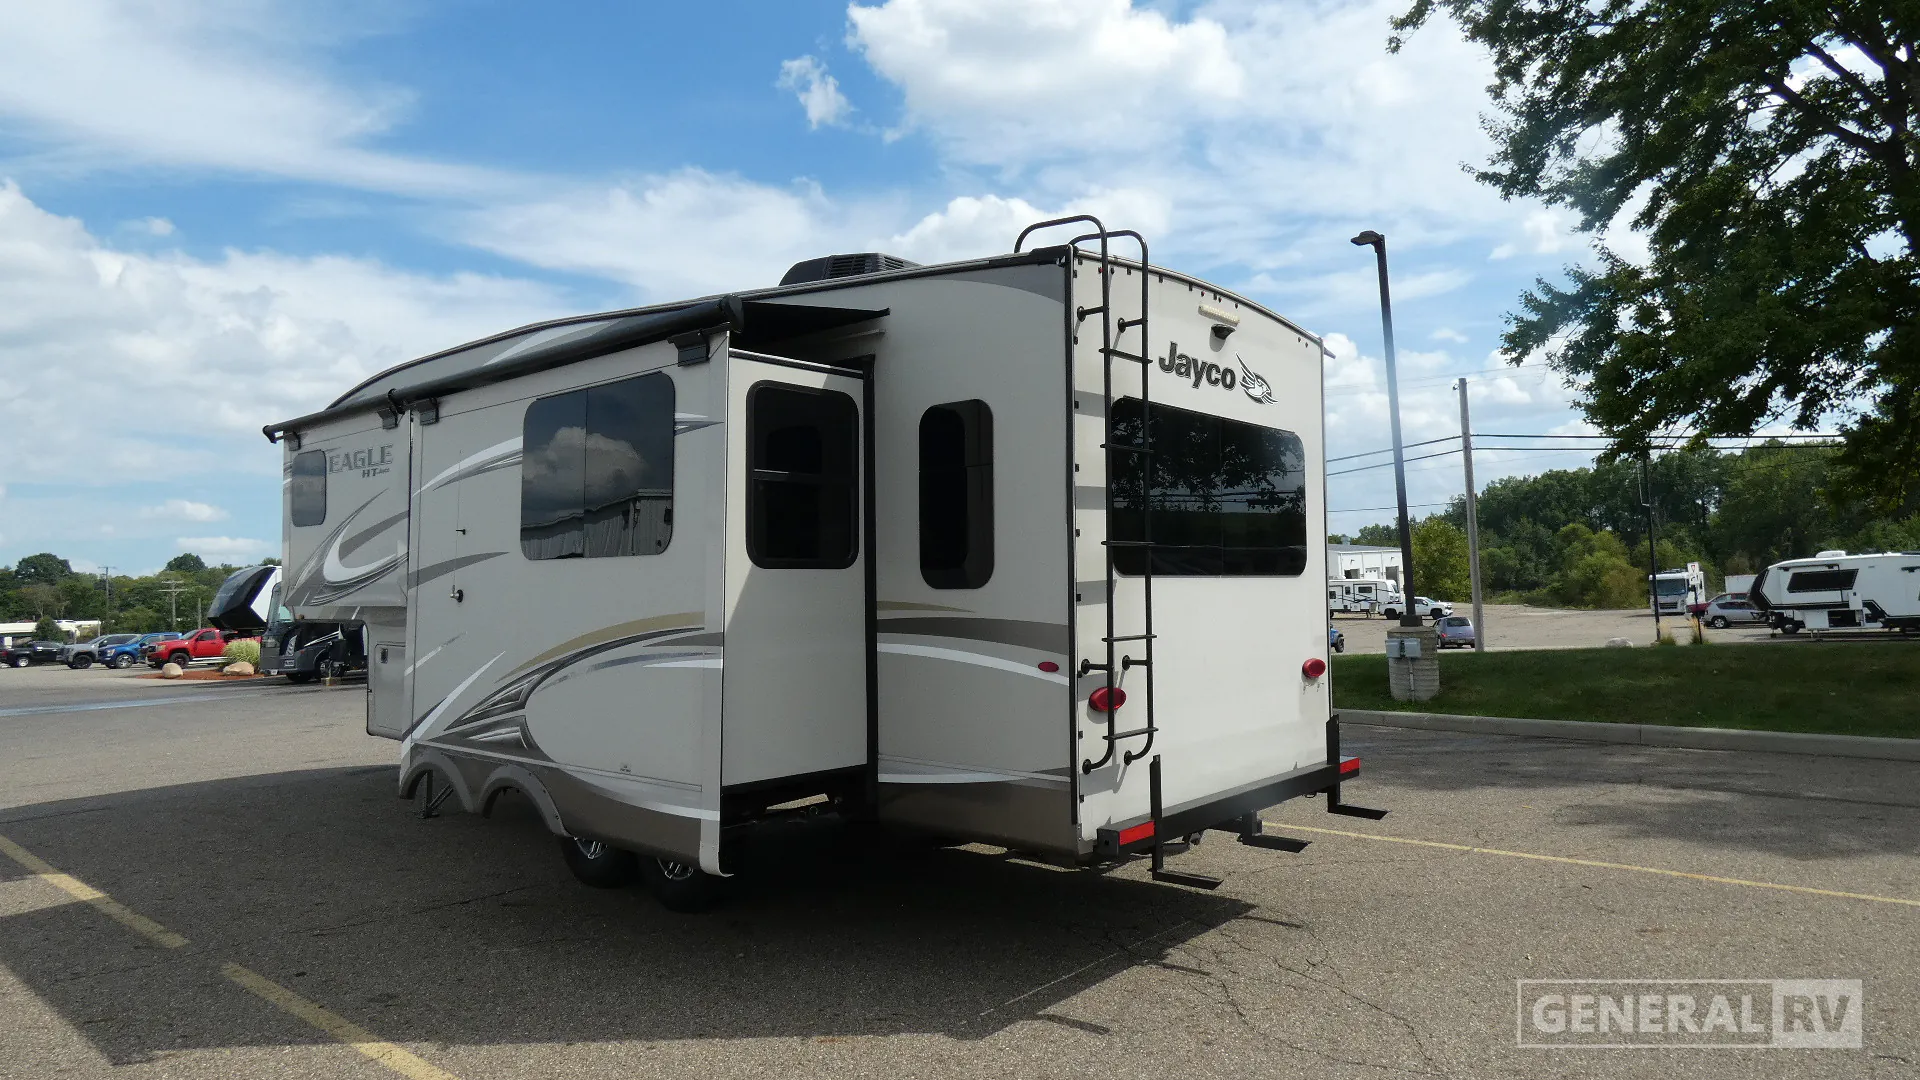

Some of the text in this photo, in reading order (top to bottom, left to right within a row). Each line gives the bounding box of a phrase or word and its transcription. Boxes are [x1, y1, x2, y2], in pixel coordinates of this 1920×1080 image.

[1158, 341, 1236, 391] Jayco
[329, 443, 393, 474] EAGLE
[362, 468, 377, 478] HT
